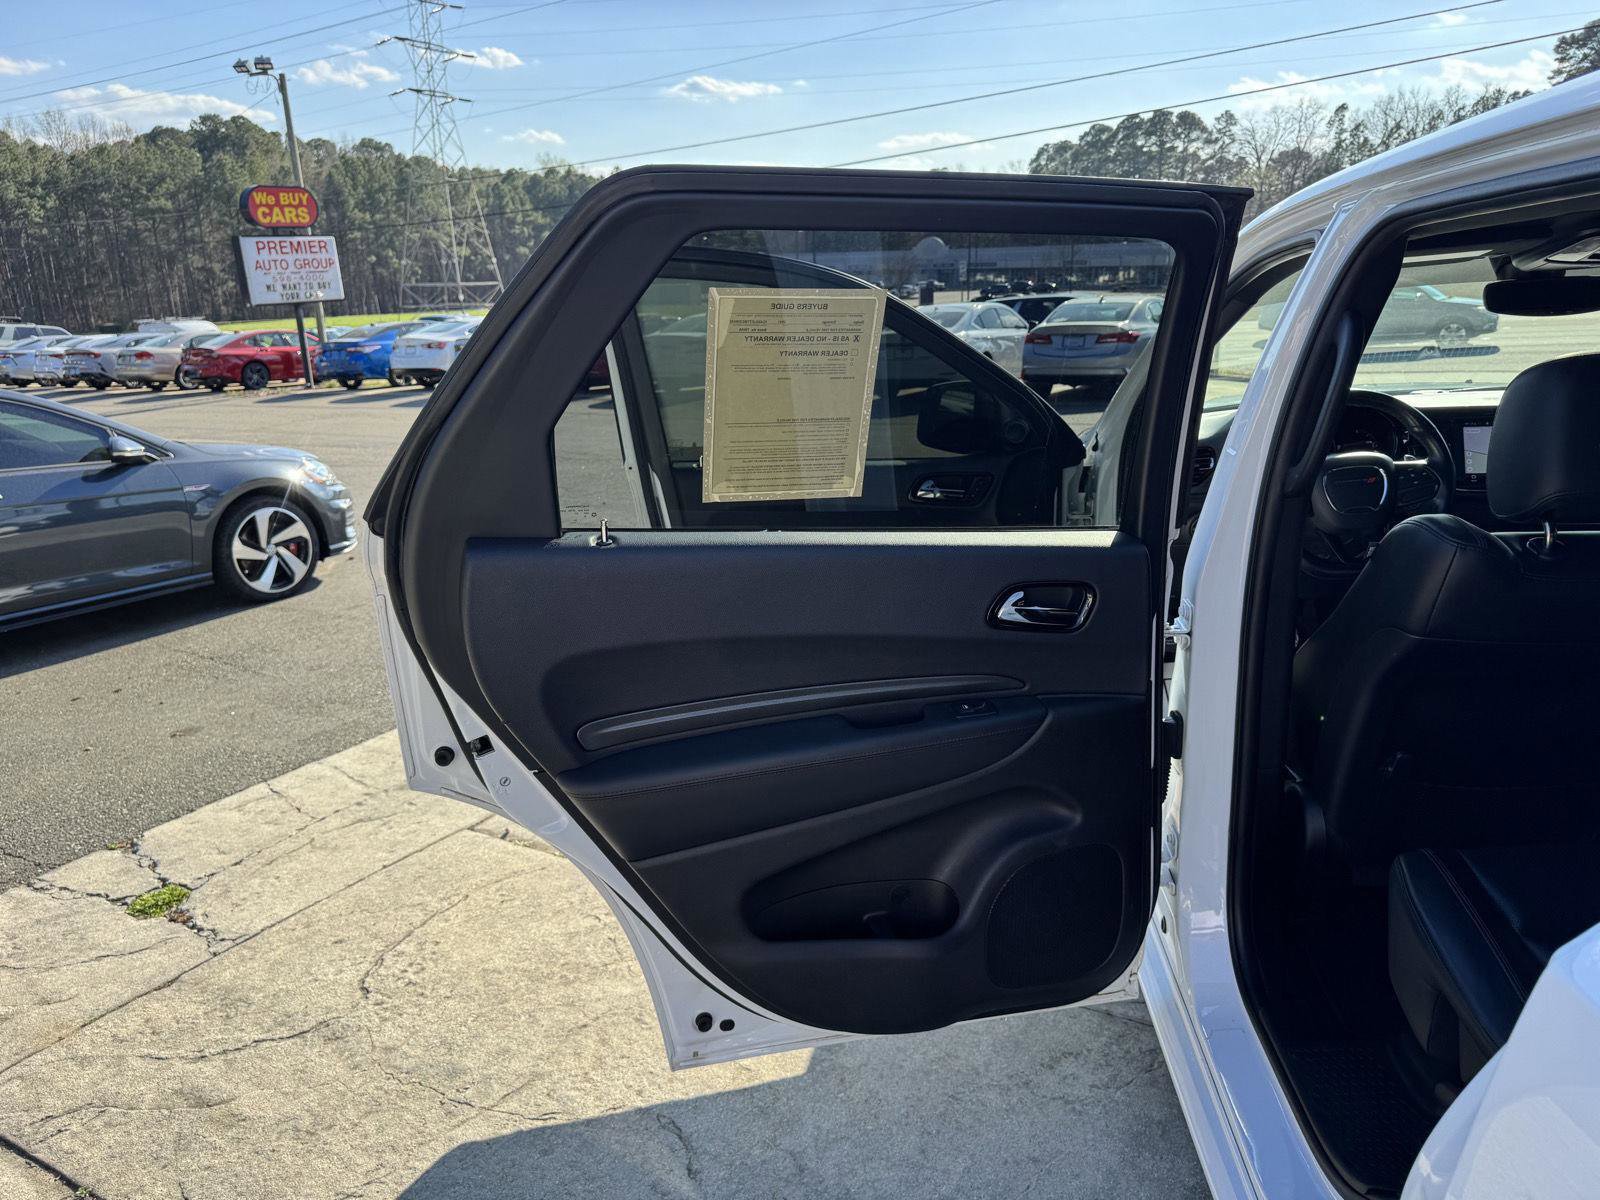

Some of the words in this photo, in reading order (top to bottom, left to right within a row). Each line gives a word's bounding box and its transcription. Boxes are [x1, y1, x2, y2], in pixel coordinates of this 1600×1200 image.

[253, 192, 276, 205] We
[280, 192, 309, 205] BUY
[257, 207, 310, 223] CARS
[255, 240, 328, 255] PREMIER
[255, 258, 289, 271] AUTO
[294, 257, 336, 270] GROUP
[281, 283, 302, 291] WANT
